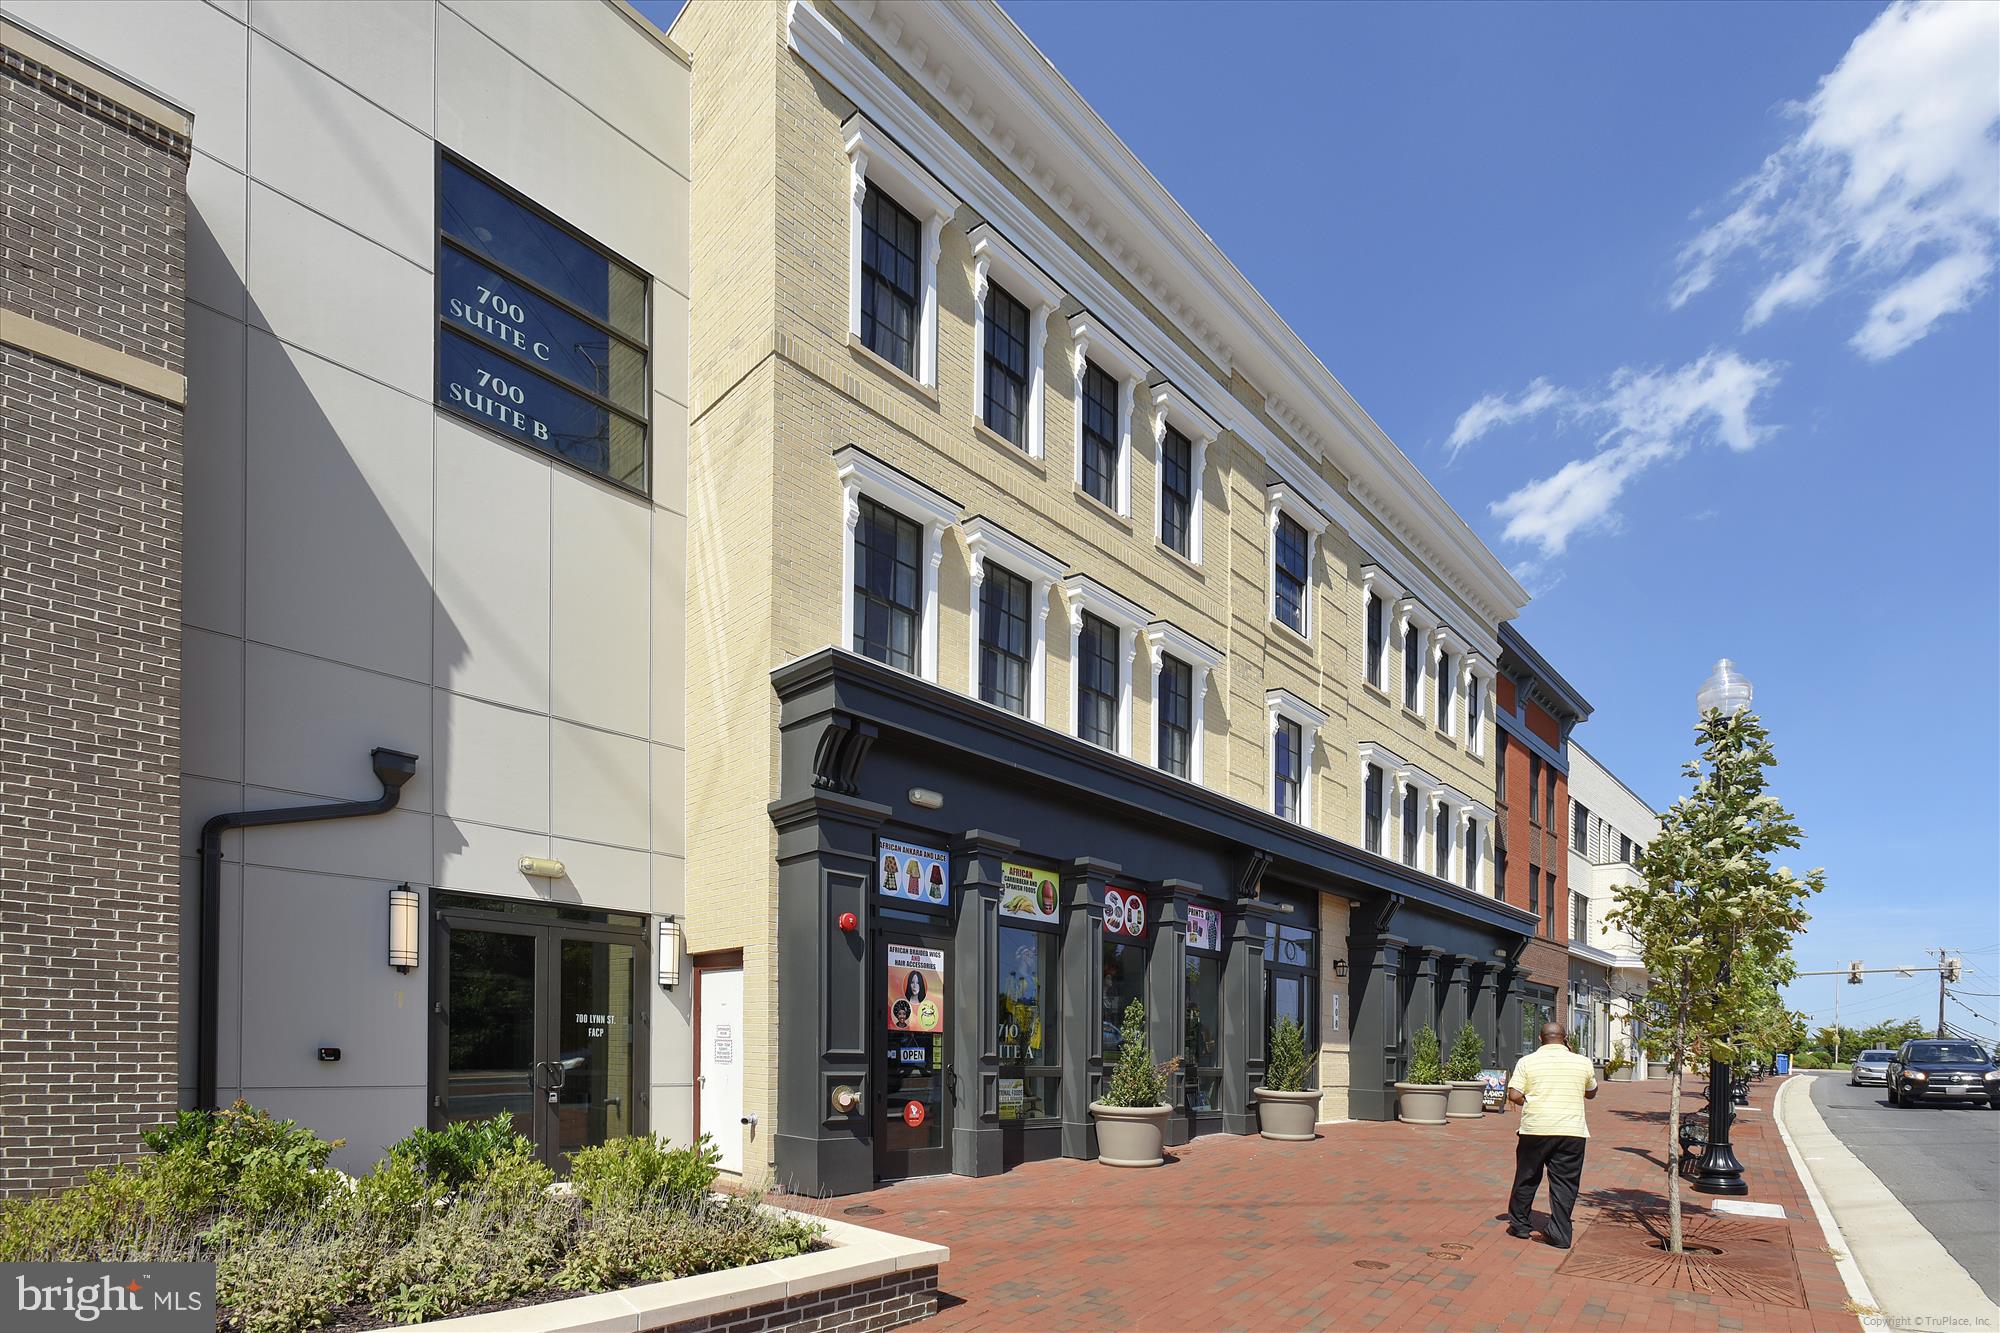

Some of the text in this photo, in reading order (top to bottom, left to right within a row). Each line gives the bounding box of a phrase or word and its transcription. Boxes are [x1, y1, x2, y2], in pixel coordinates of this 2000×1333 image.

[476, 286, 525, 324] 700
[450, 298, 550, 361] SUITE C
[476, 368, 525, 404] 700
[450, 382, 549, 441] SUITE B
[880, 841, 947, 862] AFRICAN ANKARA AND LACE
[1008, 867, 1033, 880] AFRICAN
[1005, 882, 1036, 894] SPANISH FOODS
[1029, 880, 1038, 888] AND
[889, 946, 909, 955] AFRICAN
[909, 949, 929, 957] BRAIDED
[911, 954, 920, 962] AND
[894, 959, 936, 970] HAIR ACCESSORIES
[575, 1013, 617, 1025] 700 LYNN ST.
[588, 1027, 604, 1039] FACP
[998, 1023, 1018, 1039] 710
[902, 1050, 924, 1060] OPEN
[1024, 1044, 1034, 1059] A
